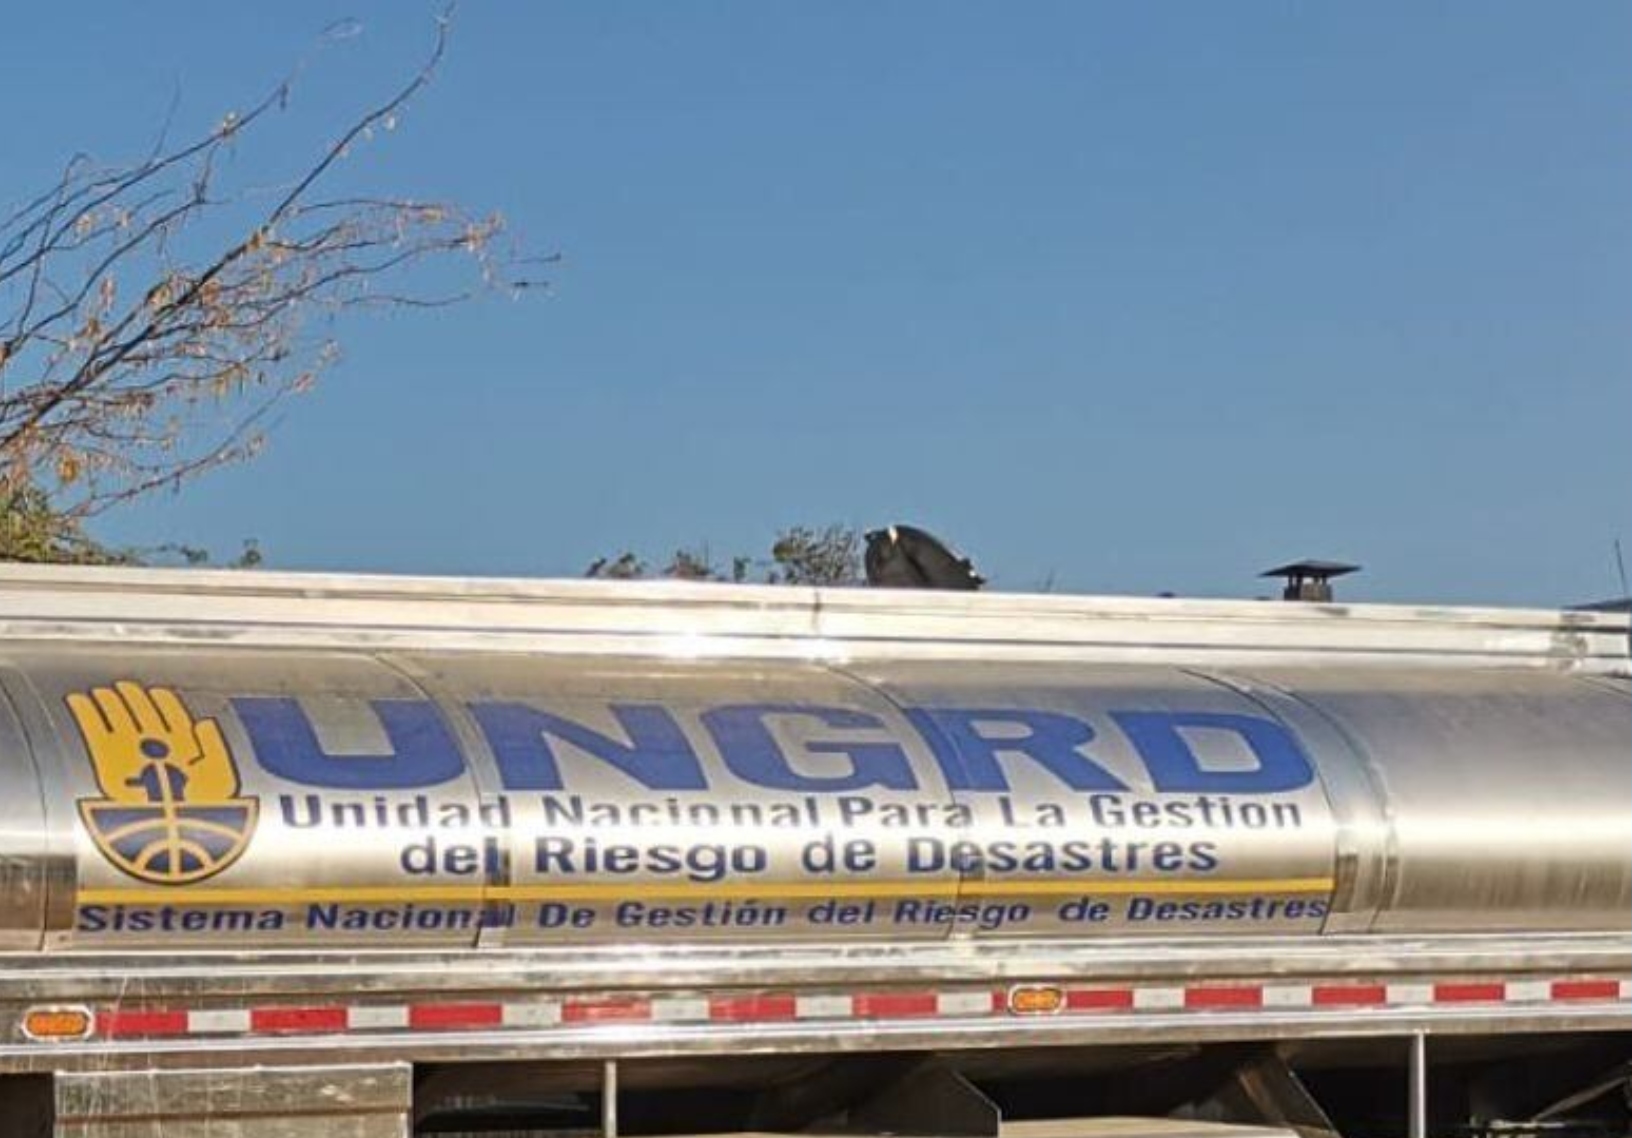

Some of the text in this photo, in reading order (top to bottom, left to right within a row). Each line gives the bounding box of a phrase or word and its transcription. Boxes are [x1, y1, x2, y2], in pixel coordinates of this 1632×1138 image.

[229, 698, 1314, 793] UNGRD
[279, 794, 1302, 828] Unidad Nacional Para La Gestion
[400, 833, 1219, 882] del Riesgo de Desastres
[79, 895, 1329, 932] Sistema Nacional De Gestión del Riesgo de Desastres
